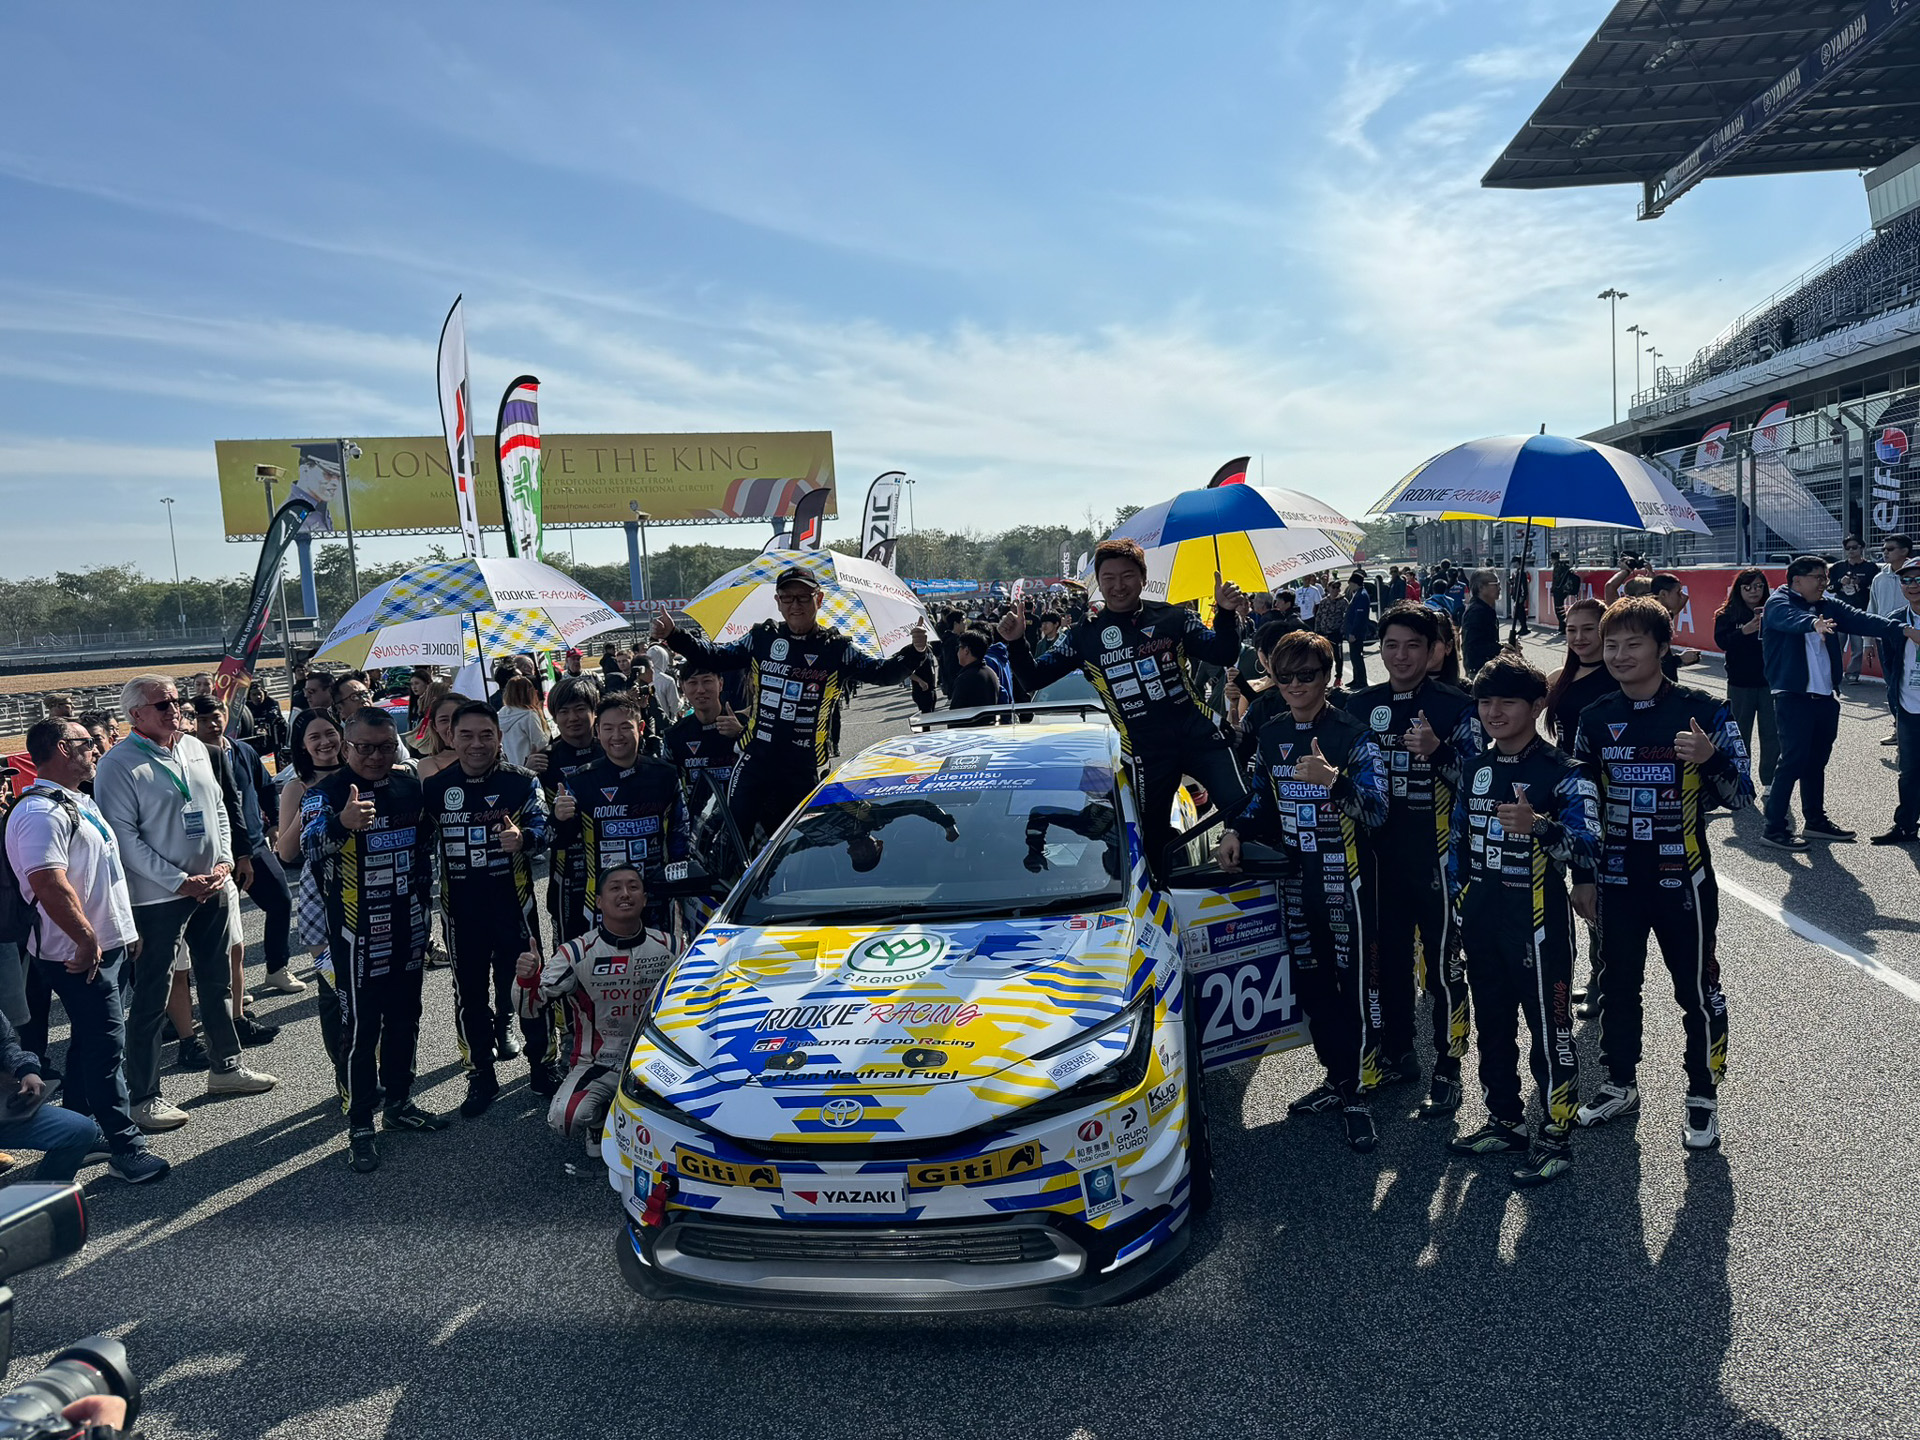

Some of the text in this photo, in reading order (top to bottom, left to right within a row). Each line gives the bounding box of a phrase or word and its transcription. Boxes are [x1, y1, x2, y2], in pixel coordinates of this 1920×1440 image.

[1829, 14, 1867, 58] YAMAHA
[1770, 67, 1801, 104] YAMAHA
[586, 447, 658, 473] THE
[672, 445, 760, 471] KING
[555, 477, 606, 486] PROFOUND
[609, 477, 644, 485] RESPECT
[648, 476, 673, 484] FROM
[604, 486, 676, 494] INTERNATIONAL
[678, 484, 714, 493] CIRCUIT
[1401, 488, 1502, 504] ROOKIE RACING
[1873, 466, 1901, 531] elf
[870, 493, 892, 543] ZIC
[1636, 501, 1697, 521] ROOKIE RACING
[838, 571, 914, 599] ROOKIE RACING
[495, 589, 588, 601] ROOKIE RACING
[621, 599, 690, 613] HOND
[1100, 637, 1173, 666] ROOKIE RACING
[760, 660, 828, 680] ROOKIE RACING
[1602, 746, 1636, 760] ROOKIE
[685, 757, 709, 767] ROOKIE
[1623, 766, 1672, 774] OGURA
[933, 771, 1002, 782] idemitsu
[1623, 773, 1672, 781] CLUTCH
[865, 778, 1037, 795] SUPER ENDURANCE
[875, 788, 932, 797] SOUTHEAST
[593, 805, 629, 819] ROOKIE
[1468, 798, 1496, 812] ROOKIE
[440, 808, 510, 824] ROOKIE RACING
[618, 819, 657, 829] OGURA
[618, 825, 658, 835] CLUTCH
[1237, 919, 1263, 930] idemitsu
[1214, 933, 1235, 945] SUPER
[1236, 923, 1277, 939] ENDURANCE
[593, 963, 627, 974] GR
[843, 971, 927, 984] C.P.GROUP
[1201, 953, 1297, 1044] 264
[1370, 989, 1383, 1029] ROOKIE
[756, 1002, 983, 1033] ROOKIE RACING
[1553, 980, 1574, 1066] ROOKIE RACING
[754, 1037, 976, 1051] GR TOYOTA GAZOO Racing
[1061, 1052, 1092, 1069] OGURA
[1063, 1055, 1096, 1073] CLUTCH
[653, 1067, 674, 1086] CLUTCH
[658, 1063, 680, 1082] OGURA
[745, 1069, 959, 1084] Carbon Neutral Fuel
[1151, 1092, 1178, 1113] GROUP
[1116, 1126, 1148, 1144] GRUPO
[1077, 1140, 1110, 1157] 和泰集團
[1118, 1134, 1149, 1153] PURDY
[1078, 1150, 1111, 1164] Hotai Group
[681, 1154, 735, 1183] Giti
[917, 1158, 993, 1184] Giti
[1094, 1176, 1108, 1188] GT
[822, 1190, 896, 1204] YAZAKI
[1087, 1199, 1121, 1215] GT CAPITAL
